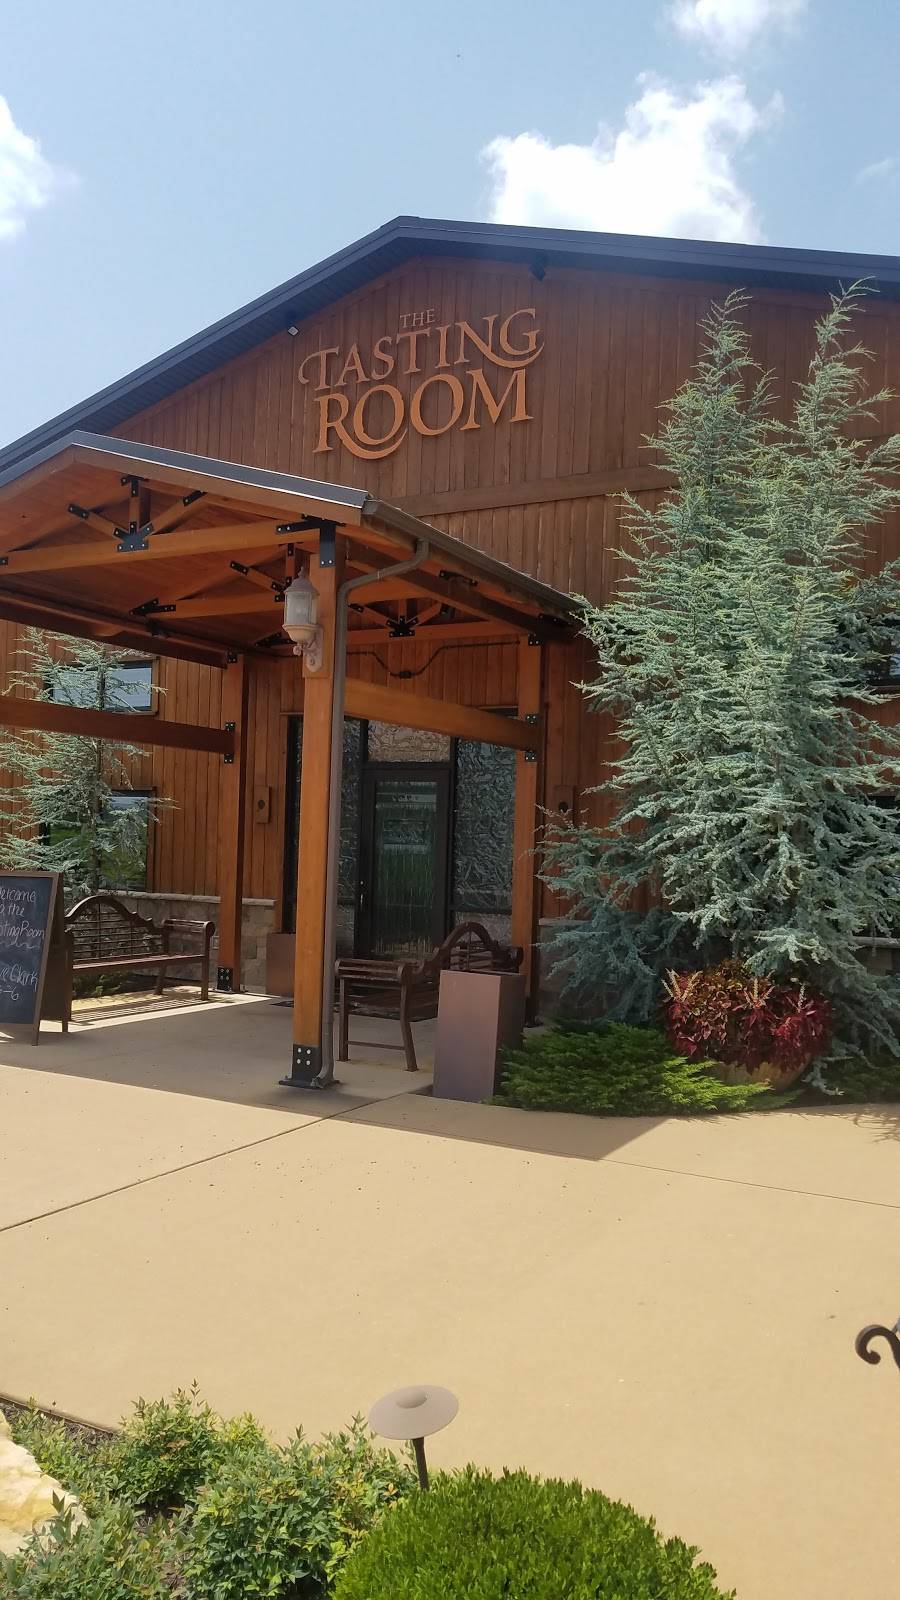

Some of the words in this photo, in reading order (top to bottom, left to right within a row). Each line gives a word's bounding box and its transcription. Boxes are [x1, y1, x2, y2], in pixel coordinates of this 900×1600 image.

[400, 308, 436, 329] THE
[298, 308, 545, 391] TASTING
[312, 368, 534, 460] ROOM
[0, 886, 37, 903] elcome
[20, 919, 45, 940] Room
